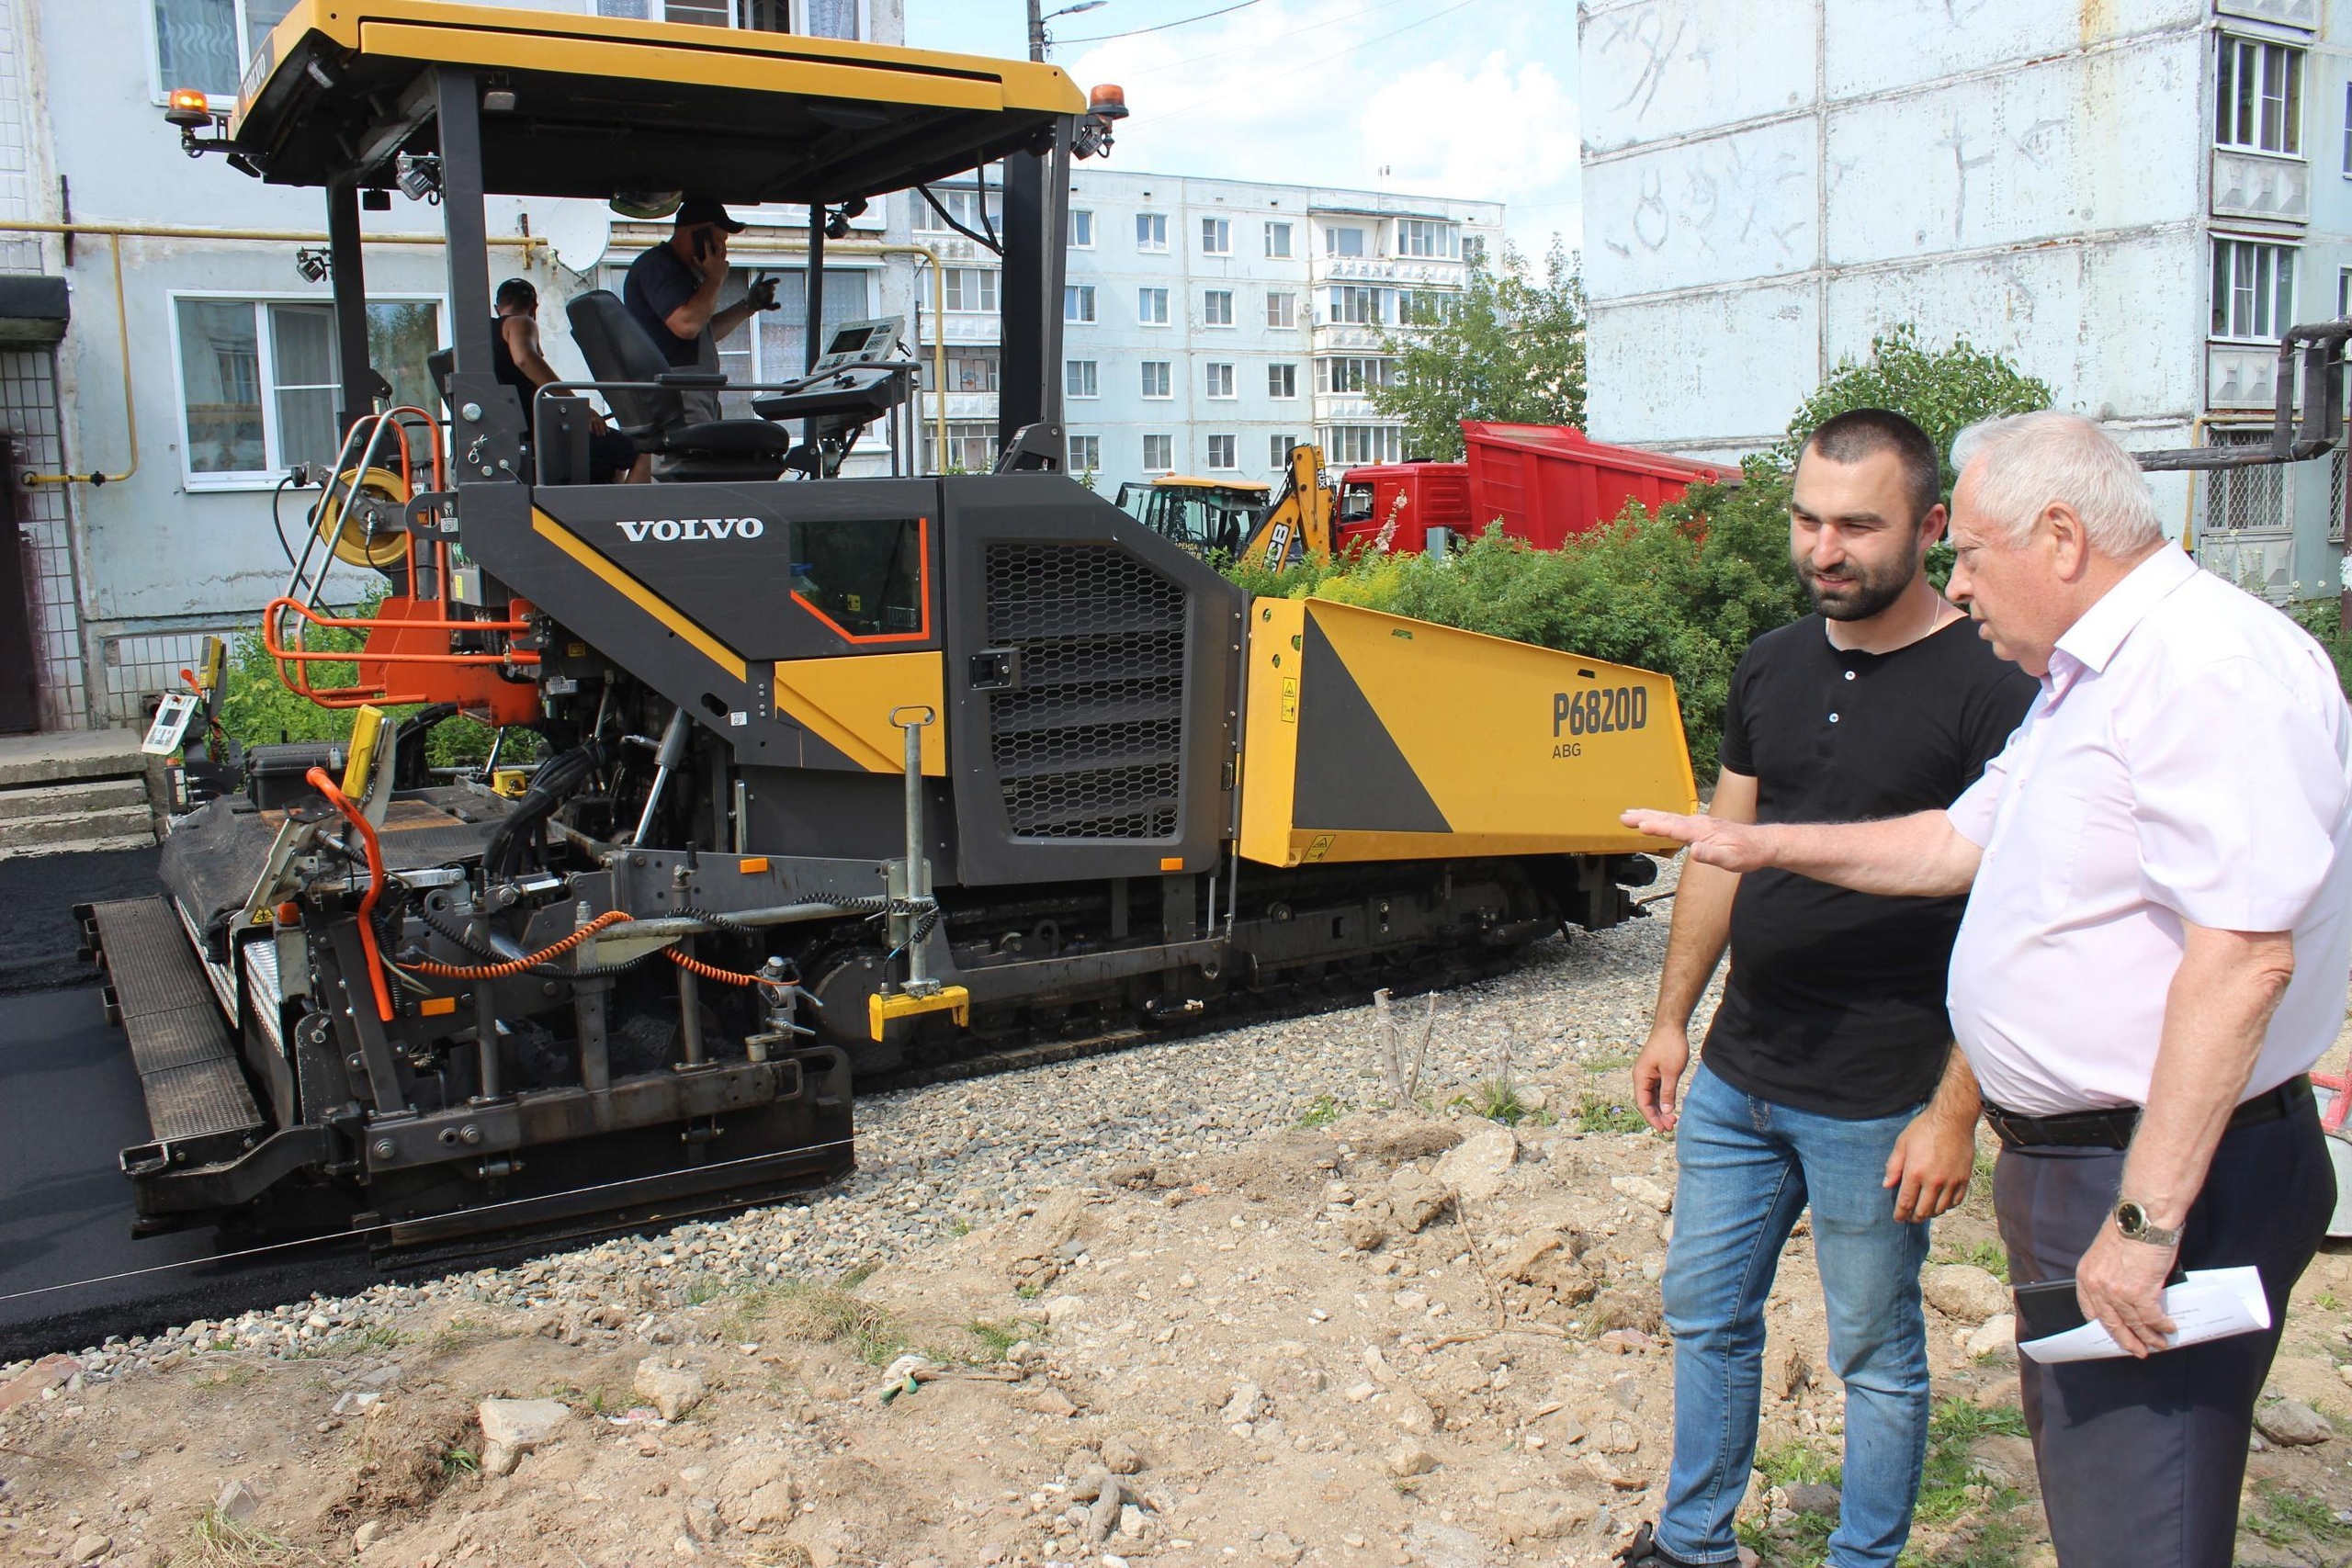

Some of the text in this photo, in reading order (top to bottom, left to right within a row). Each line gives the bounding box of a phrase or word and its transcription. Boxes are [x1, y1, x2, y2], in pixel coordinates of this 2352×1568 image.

[616, 517, 764, 542] VOLVO
[1553, 686, 1647, 738] P6820D
[1552, 742, 1582, 760] ABG
